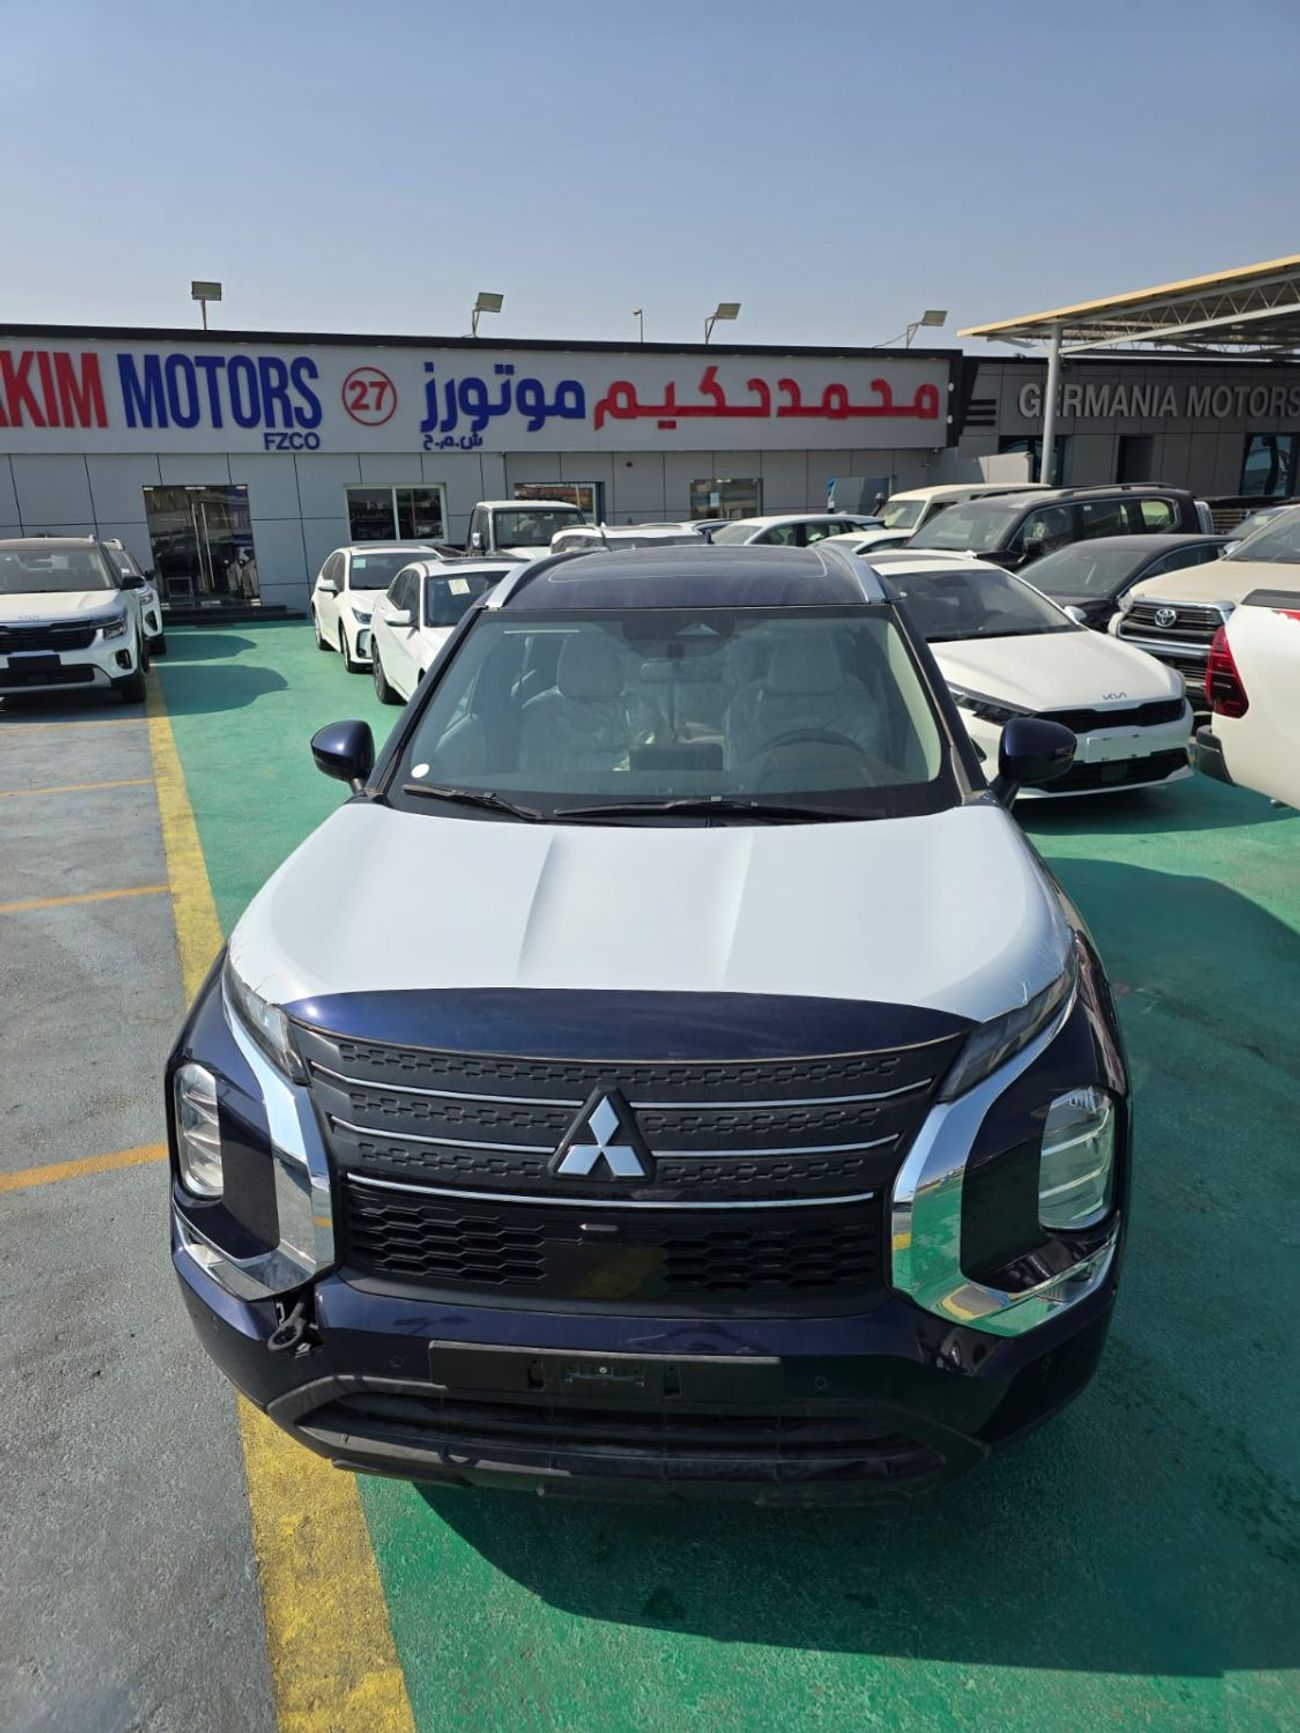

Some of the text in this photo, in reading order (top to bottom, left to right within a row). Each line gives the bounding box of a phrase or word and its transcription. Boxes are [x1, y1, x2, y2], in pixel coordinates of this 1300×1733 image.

[0, 351, 323, 430] KIM MOTORS
[348, 380, 389, 411] 27
[420, 361, 586, 433] موتورز
[1019, 383, 1300, 418] GRMANIA MOTORS
[263, 432, 321, 451] FZCO
